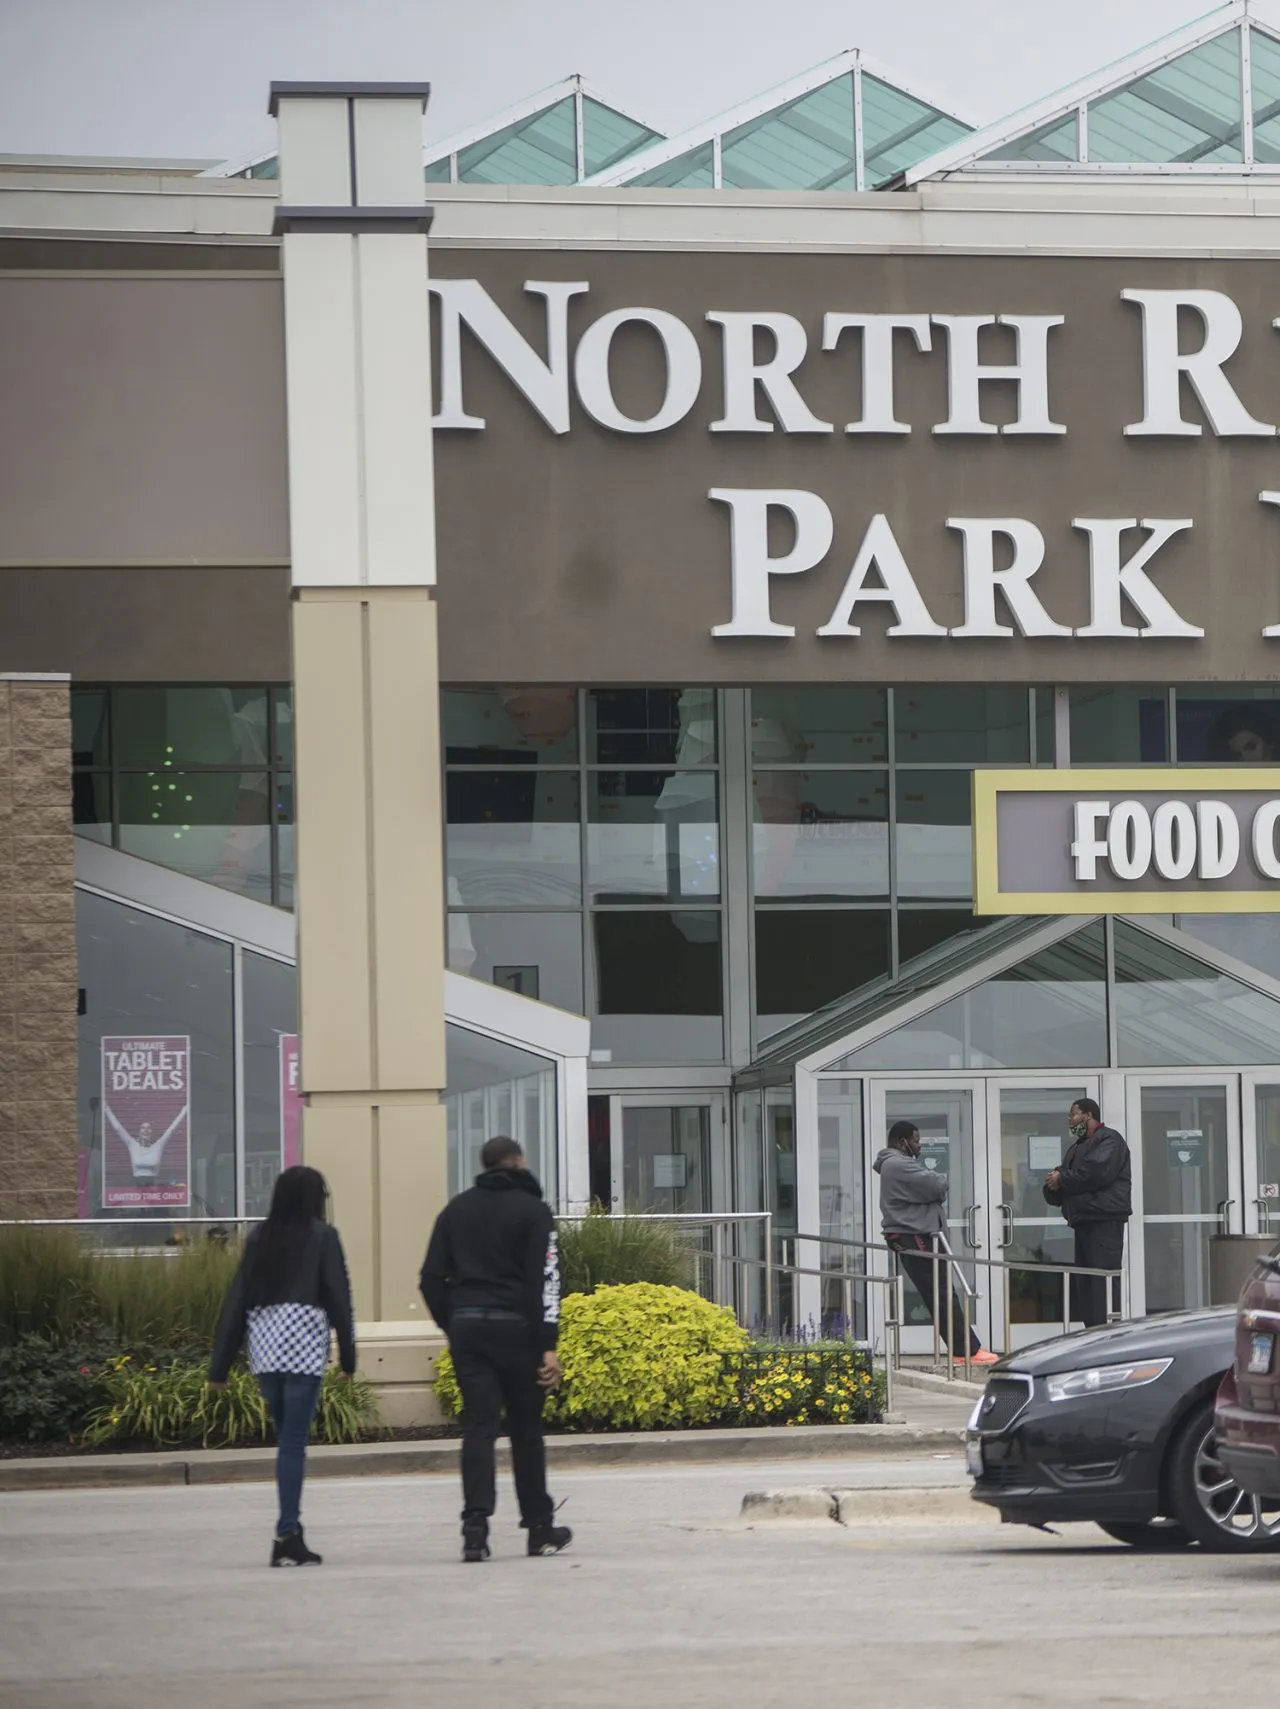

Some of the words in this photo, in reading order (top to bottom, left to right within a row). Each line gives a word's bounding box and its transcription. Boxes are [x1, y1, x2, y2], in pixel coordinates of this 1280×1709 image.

[428, 278, 1067, 435] NORTH
[707, 487, 1205, 638] PARK
[1071, 799, 1240, 880] FOOD
[122, 1041, 166, 1051] ULTIMATE
[104, 1050, 186, 1071] TABLET
[112, 1070, 185, 1091] DEALS
[108, 1192, 141, 1202] LIMITED
[142, 1192, 162, 1201] TIME
[162, 1191, 185, 1201] ONLY
